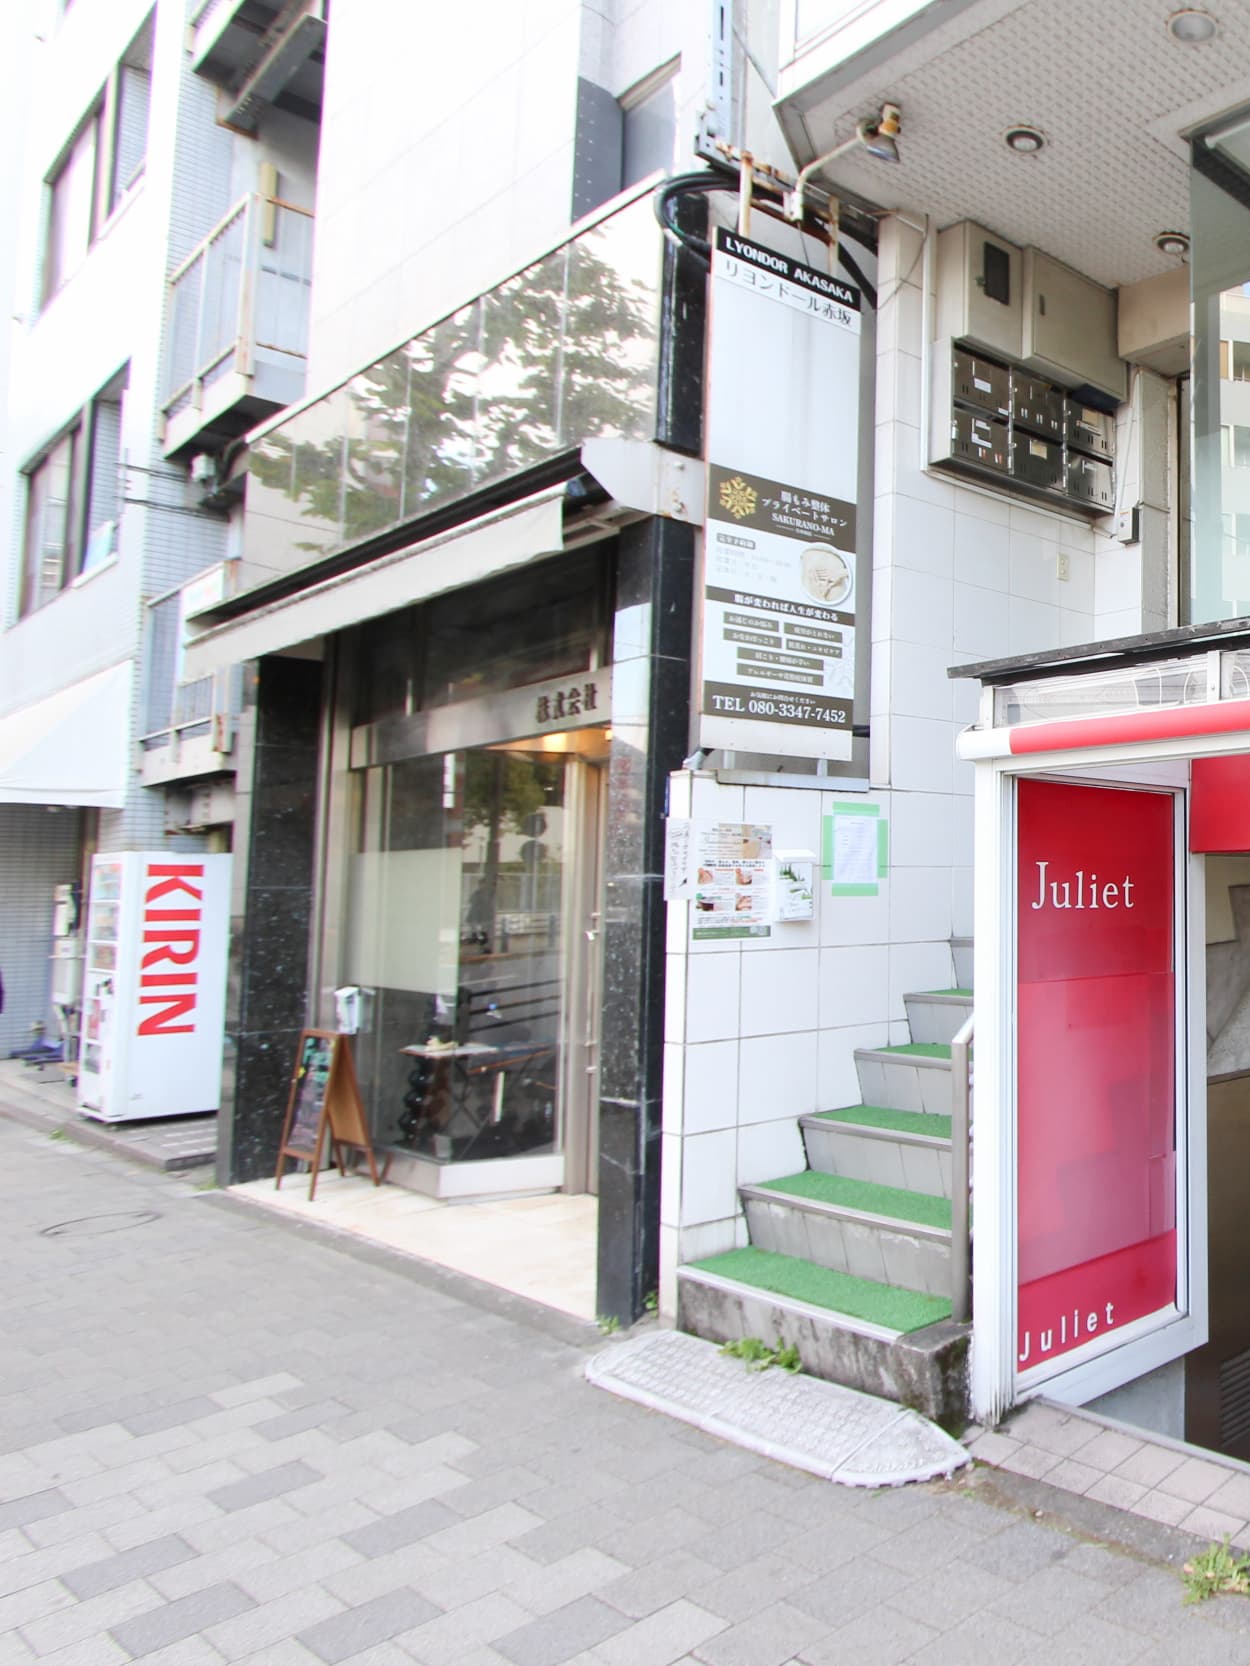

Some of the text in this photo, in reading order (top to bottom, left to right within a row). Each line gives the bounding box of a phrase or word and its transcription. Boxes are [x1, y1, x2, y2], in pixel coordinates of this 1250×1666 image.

[726, 236, 853, 303] LYONDOR AKASAKA
[761, 498, 848, 527] プライベートサロン
[771, 512, 835, 536] SAKURANO-MA
[712, 695, 846, 723] TEL 080-3347-7452
[1031, 861, 1135, 909] Juliet
[137, 864, 205, 1036] KIRIN
[1019, 1302, 1114, 1361] Juliet
